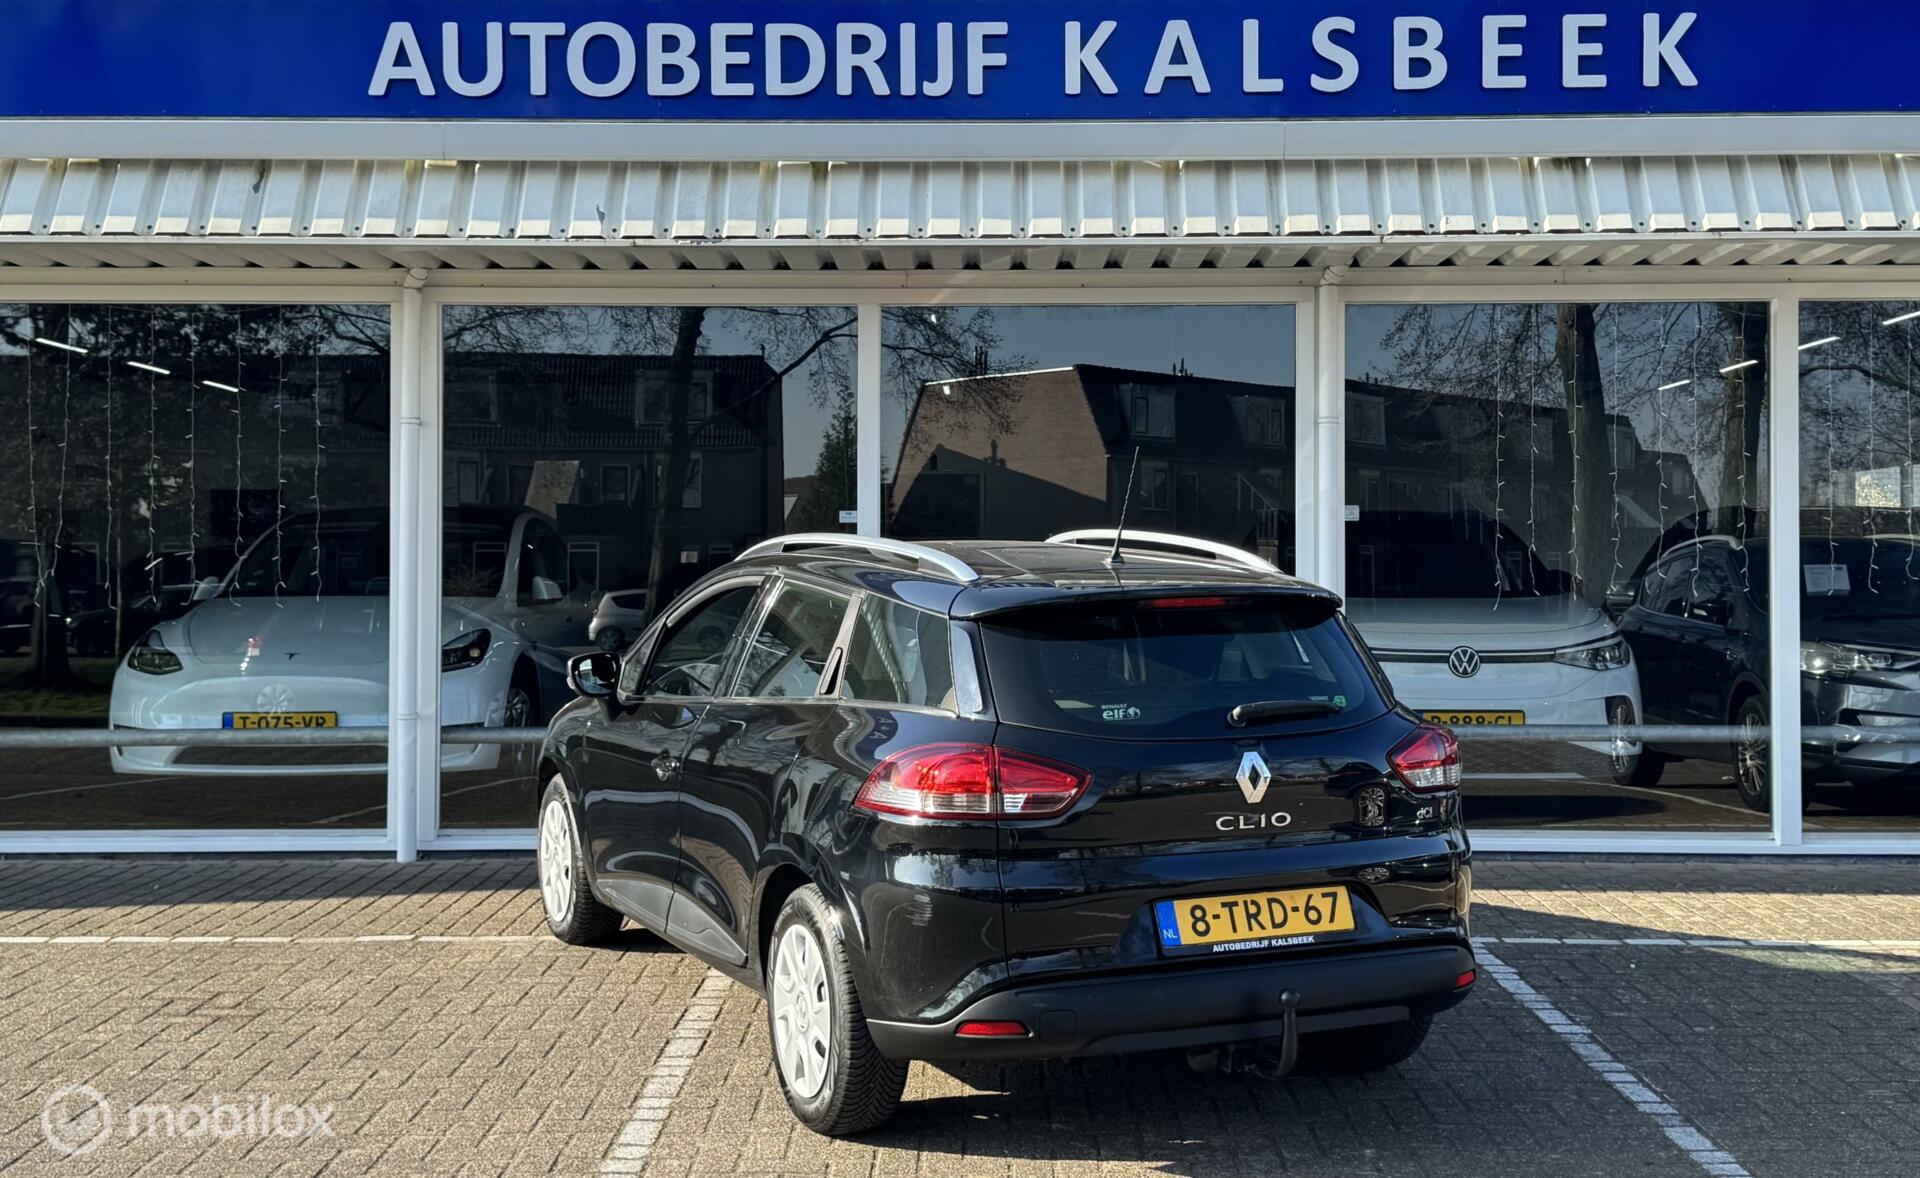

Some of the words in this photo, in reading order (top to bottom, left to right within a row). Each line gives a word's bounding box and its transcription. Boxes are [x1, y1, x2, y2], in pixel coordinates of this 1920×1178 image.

[368, 21, 1009, 97] AUTOBEDRIJF
[1064, 12, 1699, 95] KALSBEEK
[1102, 708, 1126, 720] elf
[1215, 812, 1292, 831] CLIO
[1163, 929, 1178, 939] NL
[1190, 892, 1338, 937] 8-TRD-67
[1212, 939, 1270, 953] AUTOBEDRIJF
[1271, 935, 1315, 946] KALSBEEK
